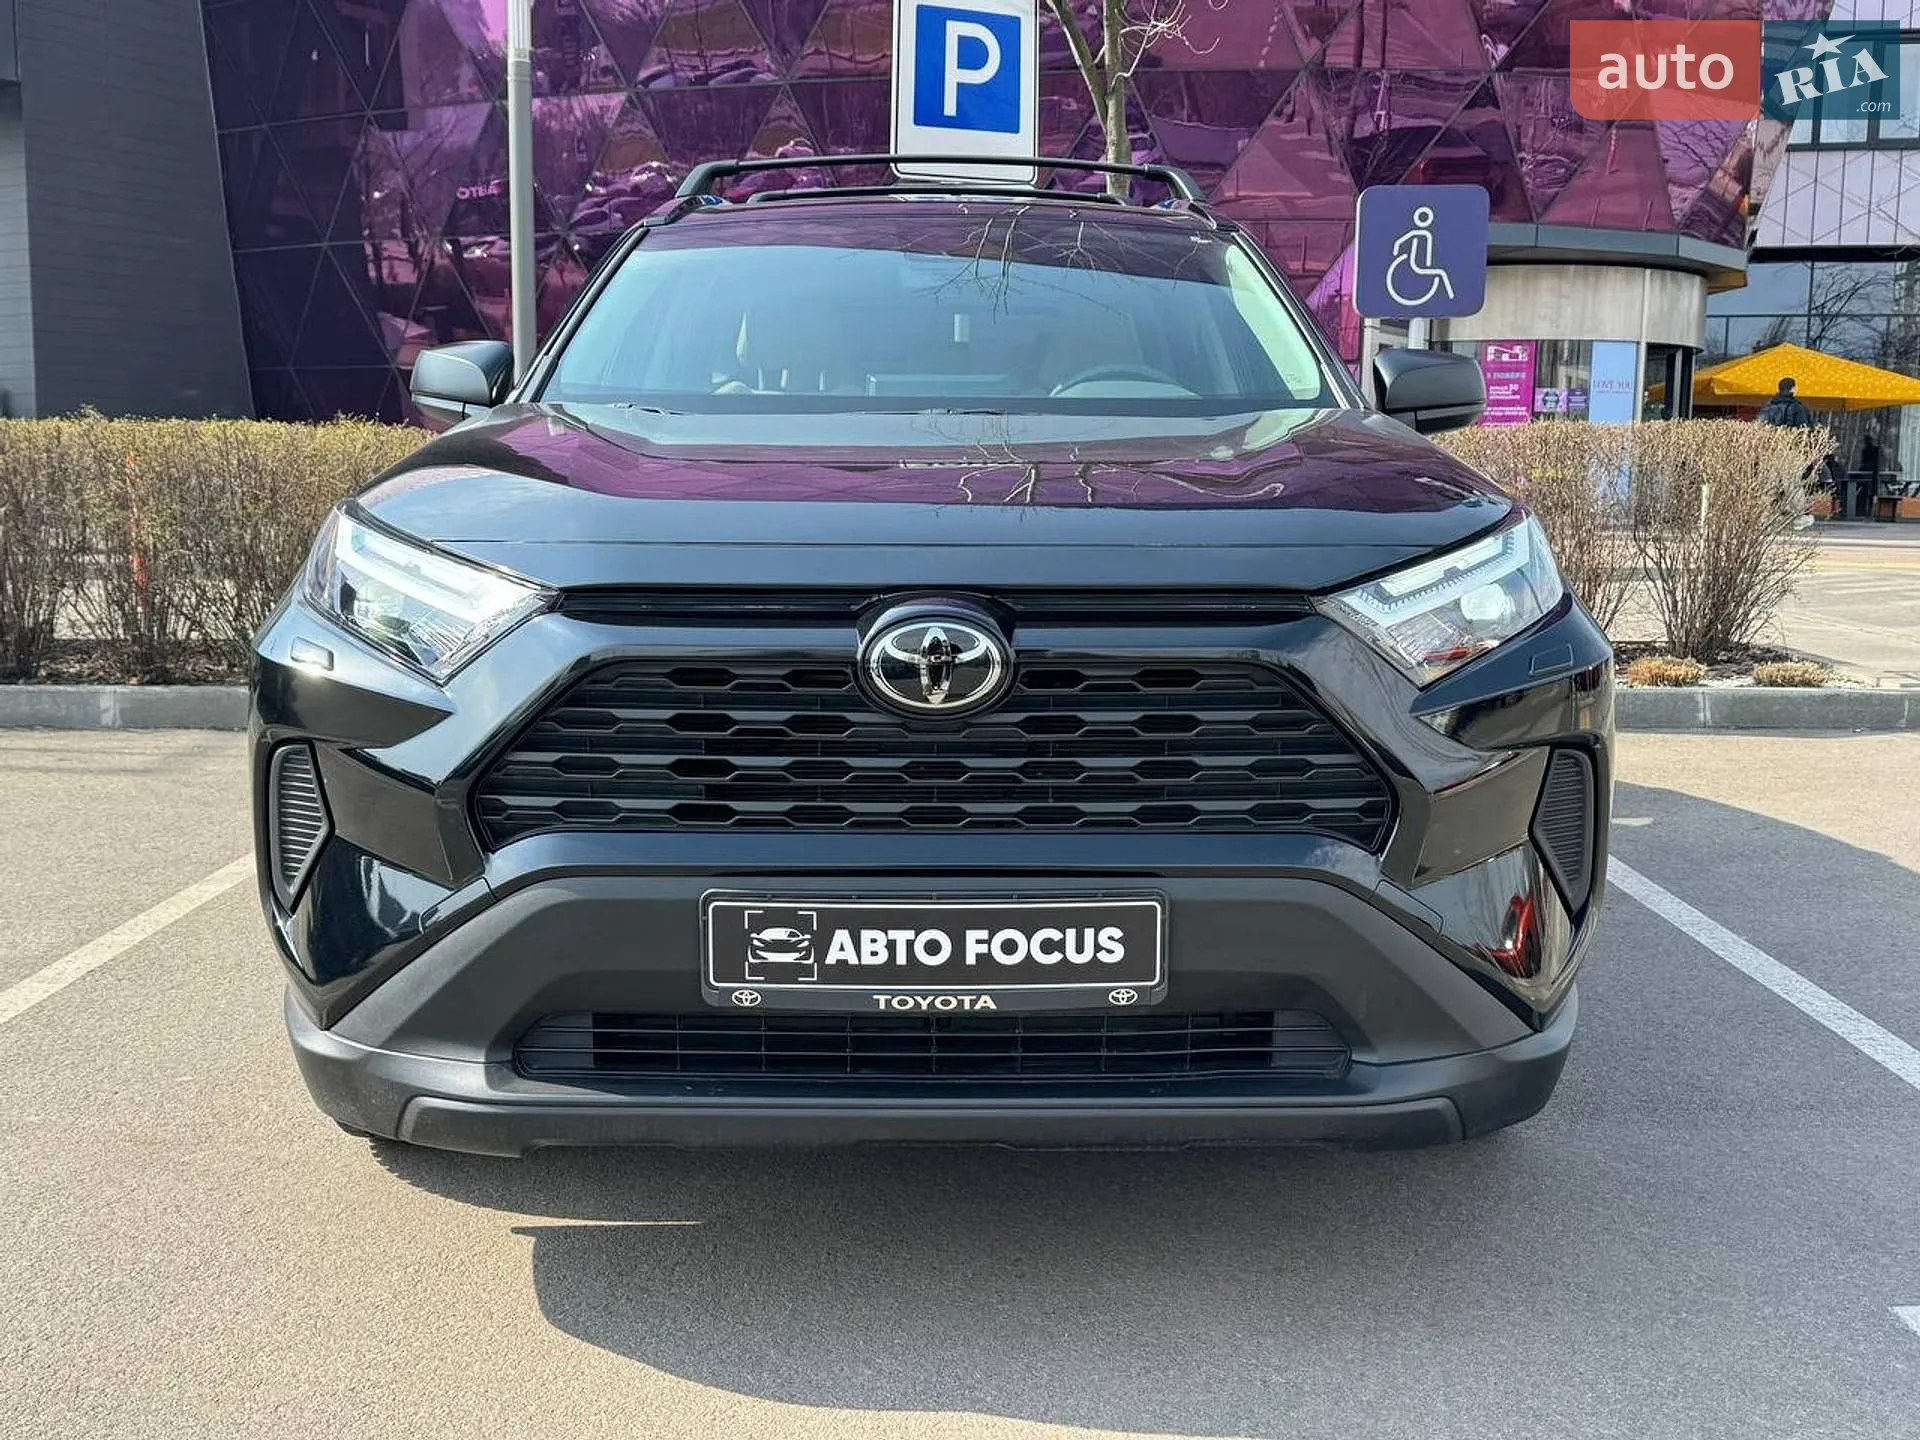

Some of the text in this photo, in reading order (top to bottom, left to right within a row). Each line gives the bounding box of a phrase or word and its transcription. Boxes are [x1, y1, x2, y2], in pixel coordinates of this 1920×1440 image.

[944, 20, 1001, 117] P
[965, 926, 1125, 966] FOCUS
[873, 994, 998, 1010] TOYOTA
